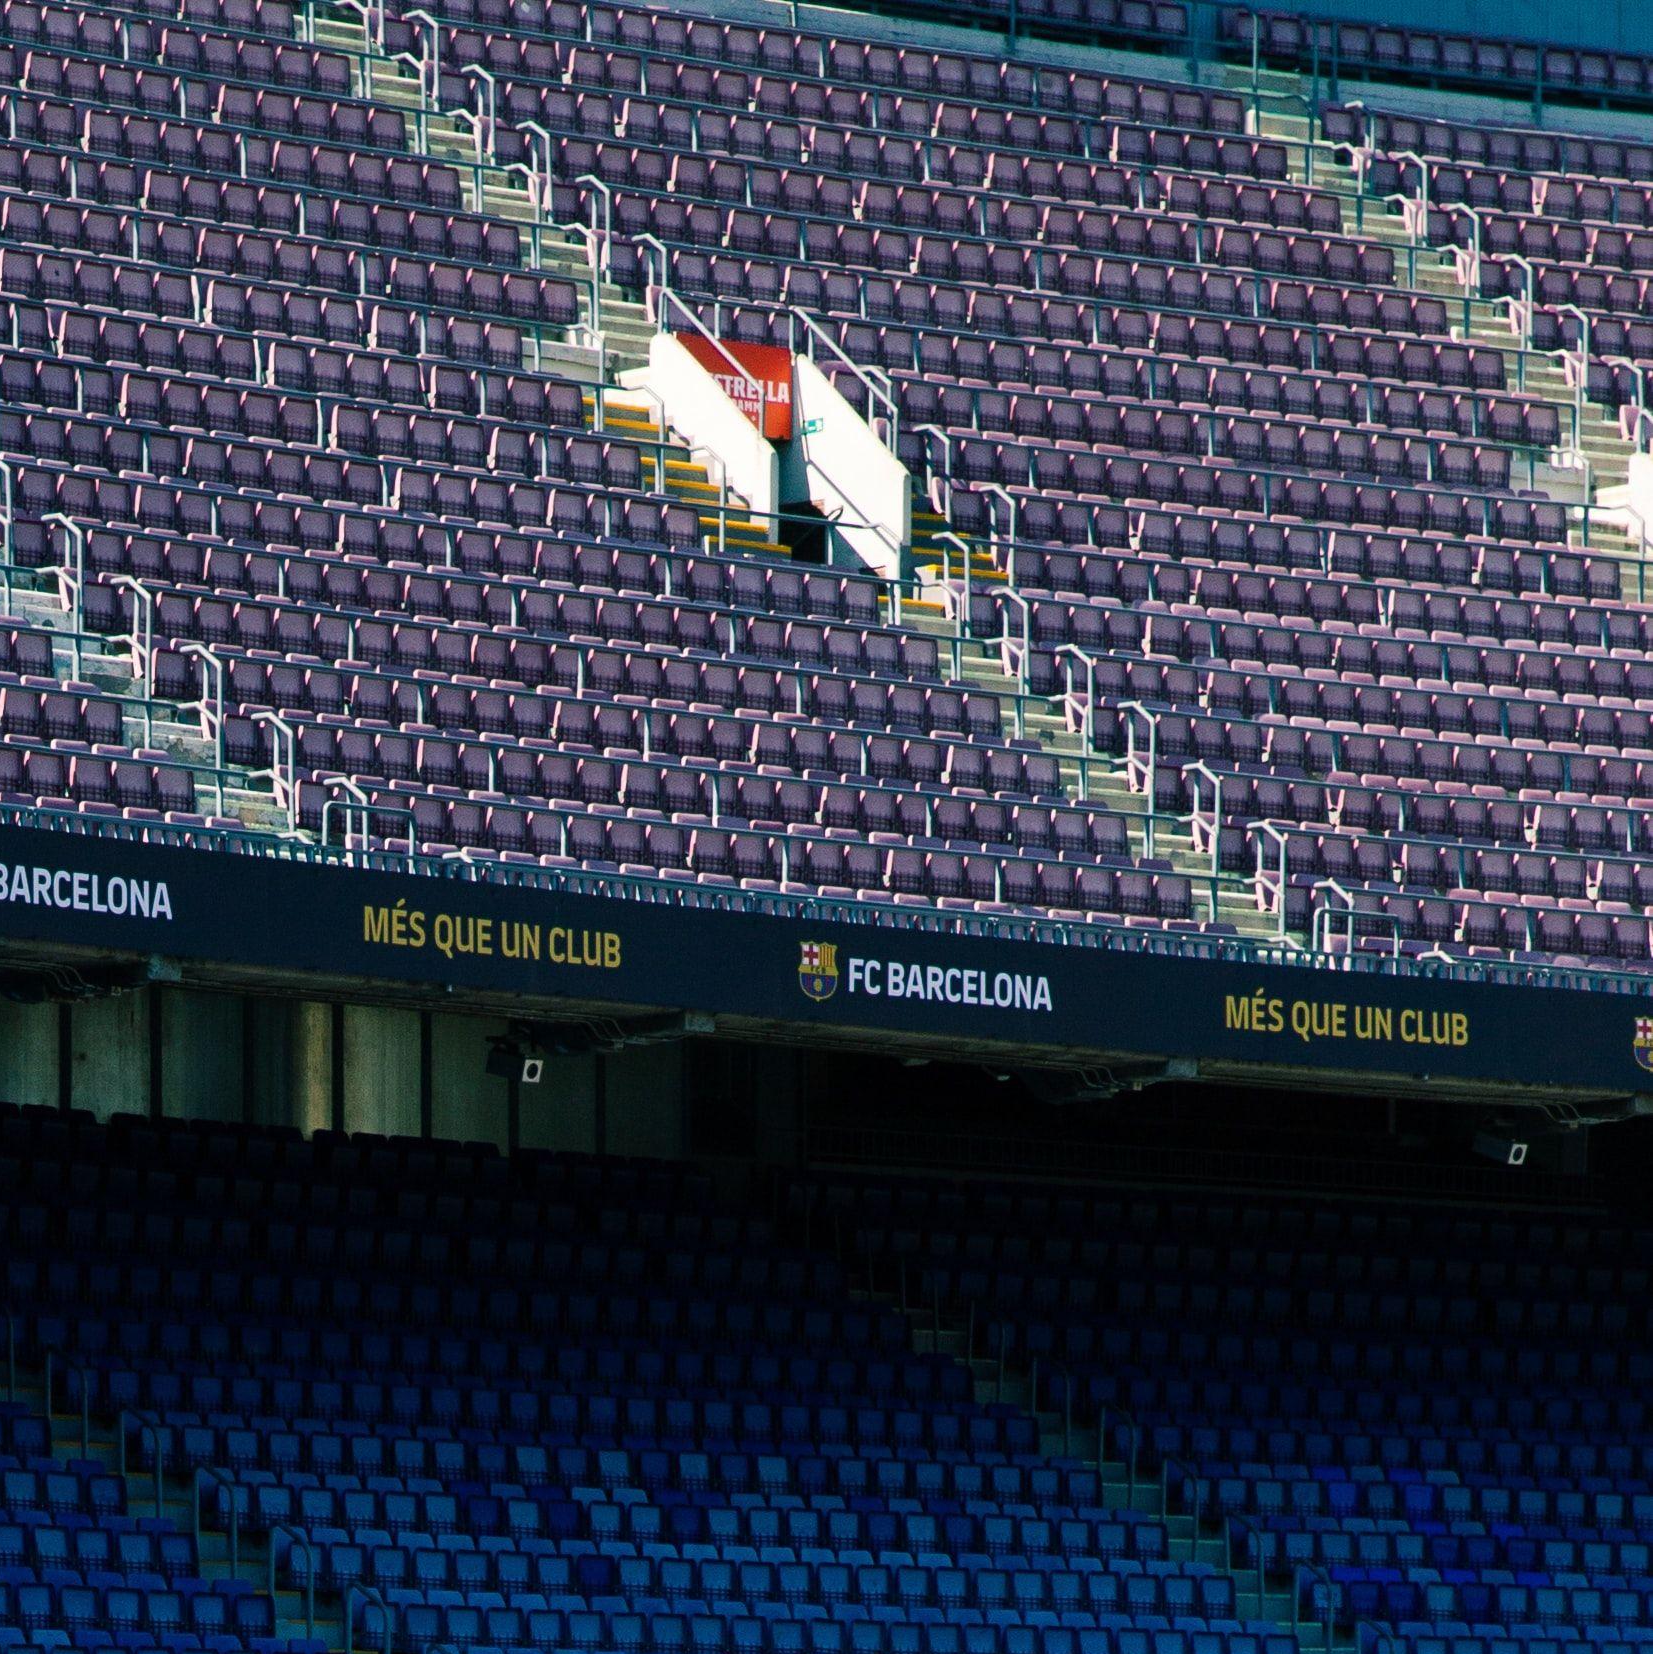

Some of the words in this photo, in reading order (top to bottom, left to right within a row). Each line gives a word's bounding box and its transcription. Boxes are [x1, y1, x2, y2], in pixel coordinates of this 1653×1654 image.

[713, 373, 790, 404] TRELA
[732, 398, 759, 413] AMM
[363, 898, 426, 948] MÉS
[433, 914, 493, 958] QUE
[501, 922, 542, 960] UN
[548, 927, 623, 969] CLUB
[848, 958, 882, 995] FC
[887, 962, 1054, 1013] BARCELONA
[1225, 987, 1285, 1033] MÉS
[1291, 1000, 1347, 1042] QUE
[1354, 1007, 1392, 1041] UN
[1399, 1009, 1468, 1046] CLUB
